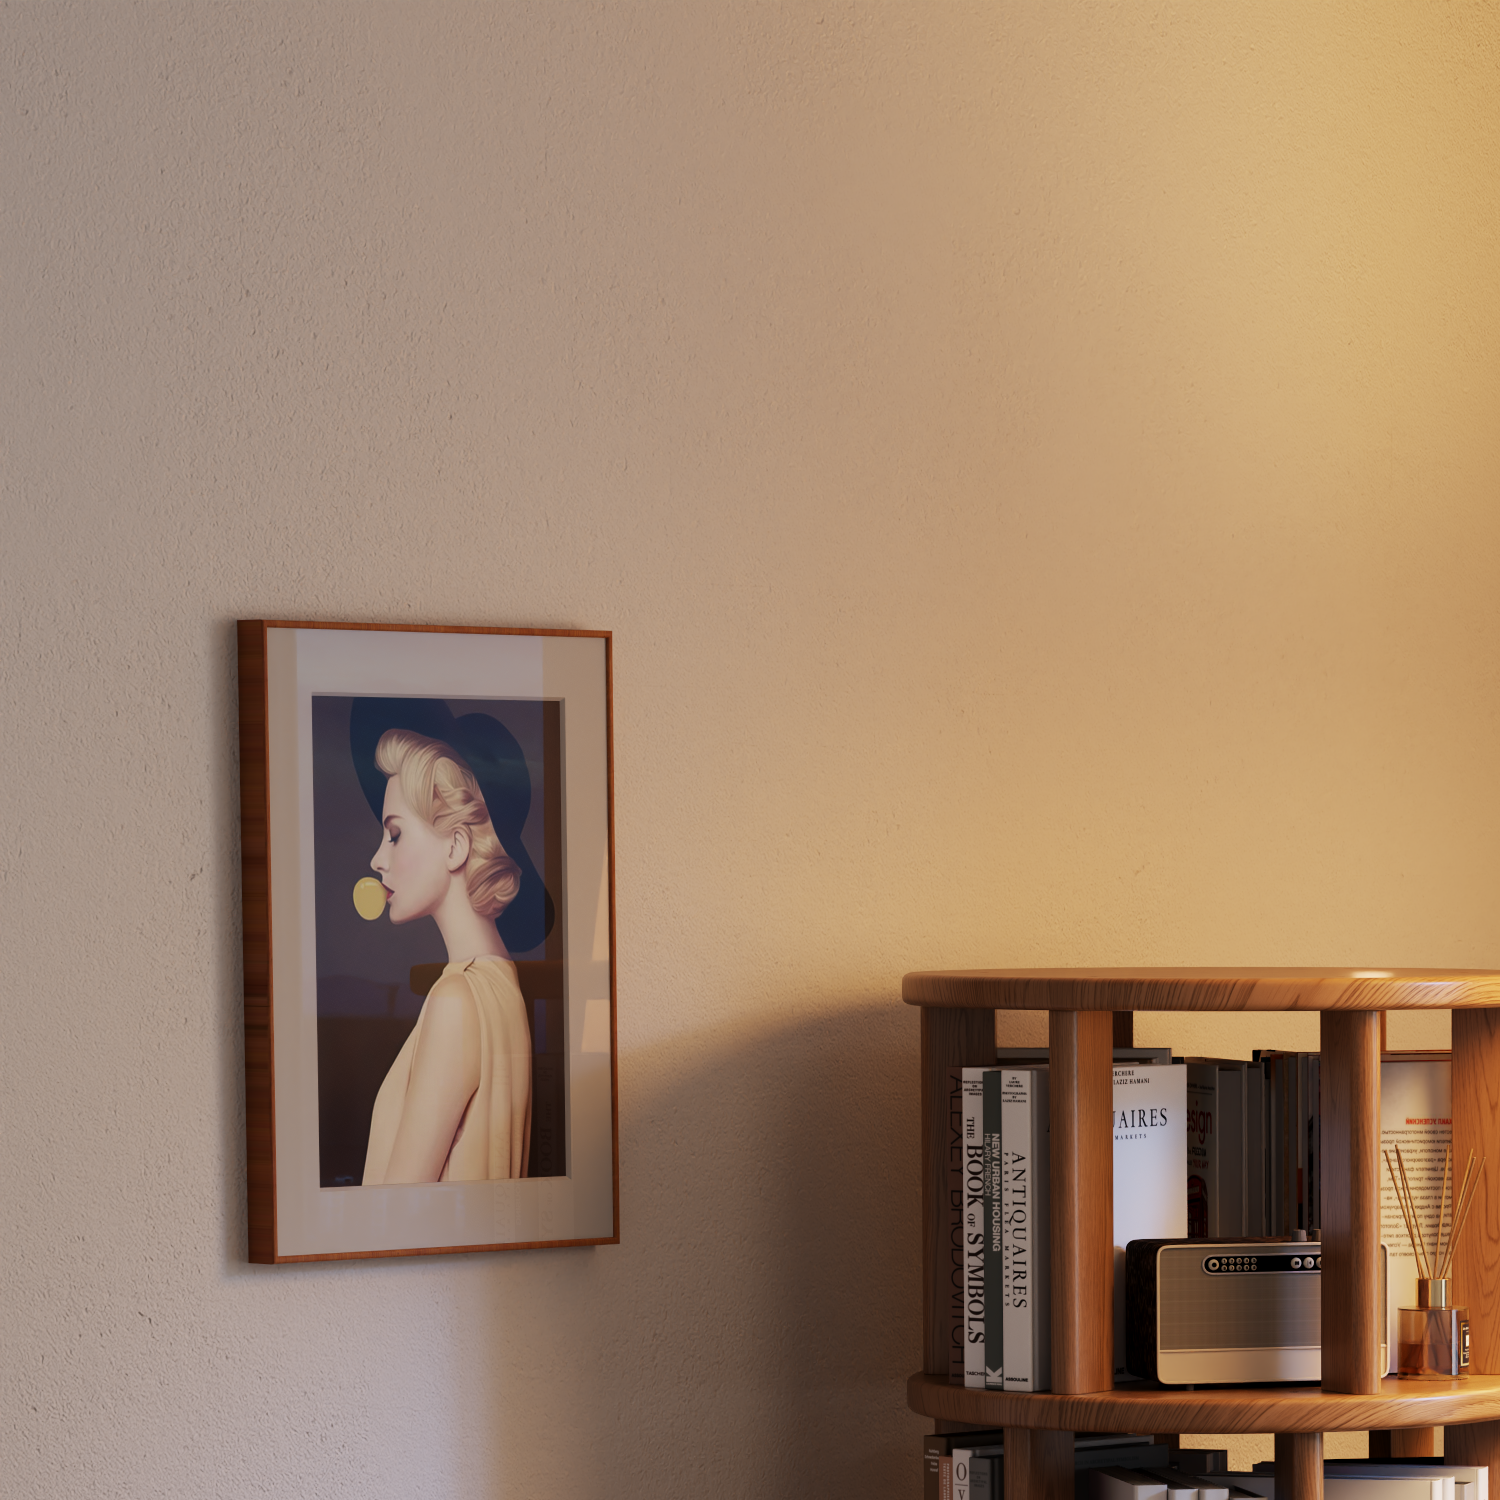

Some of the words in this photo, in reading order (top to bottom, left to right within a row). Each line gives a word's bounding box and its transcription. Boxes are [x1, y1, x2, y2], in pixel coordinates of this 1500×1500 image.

[966, 1117, 975, 1139] THE
[1187, 1100, 1212, 1145] esign
[991, 1133, 1000, 1158] NEW
[966, 1144, 984, 1208] BOOK
[991, 1161, 1000, 1199] URBAN
[967, 1213, 976, 1227] OF
[992, 1201, 1000, 1252] HOUSING
[1009, 1151, 1028, 1308] ANTIQUAIRES
[967, 1232, 985, 1344] SYMBOLS
